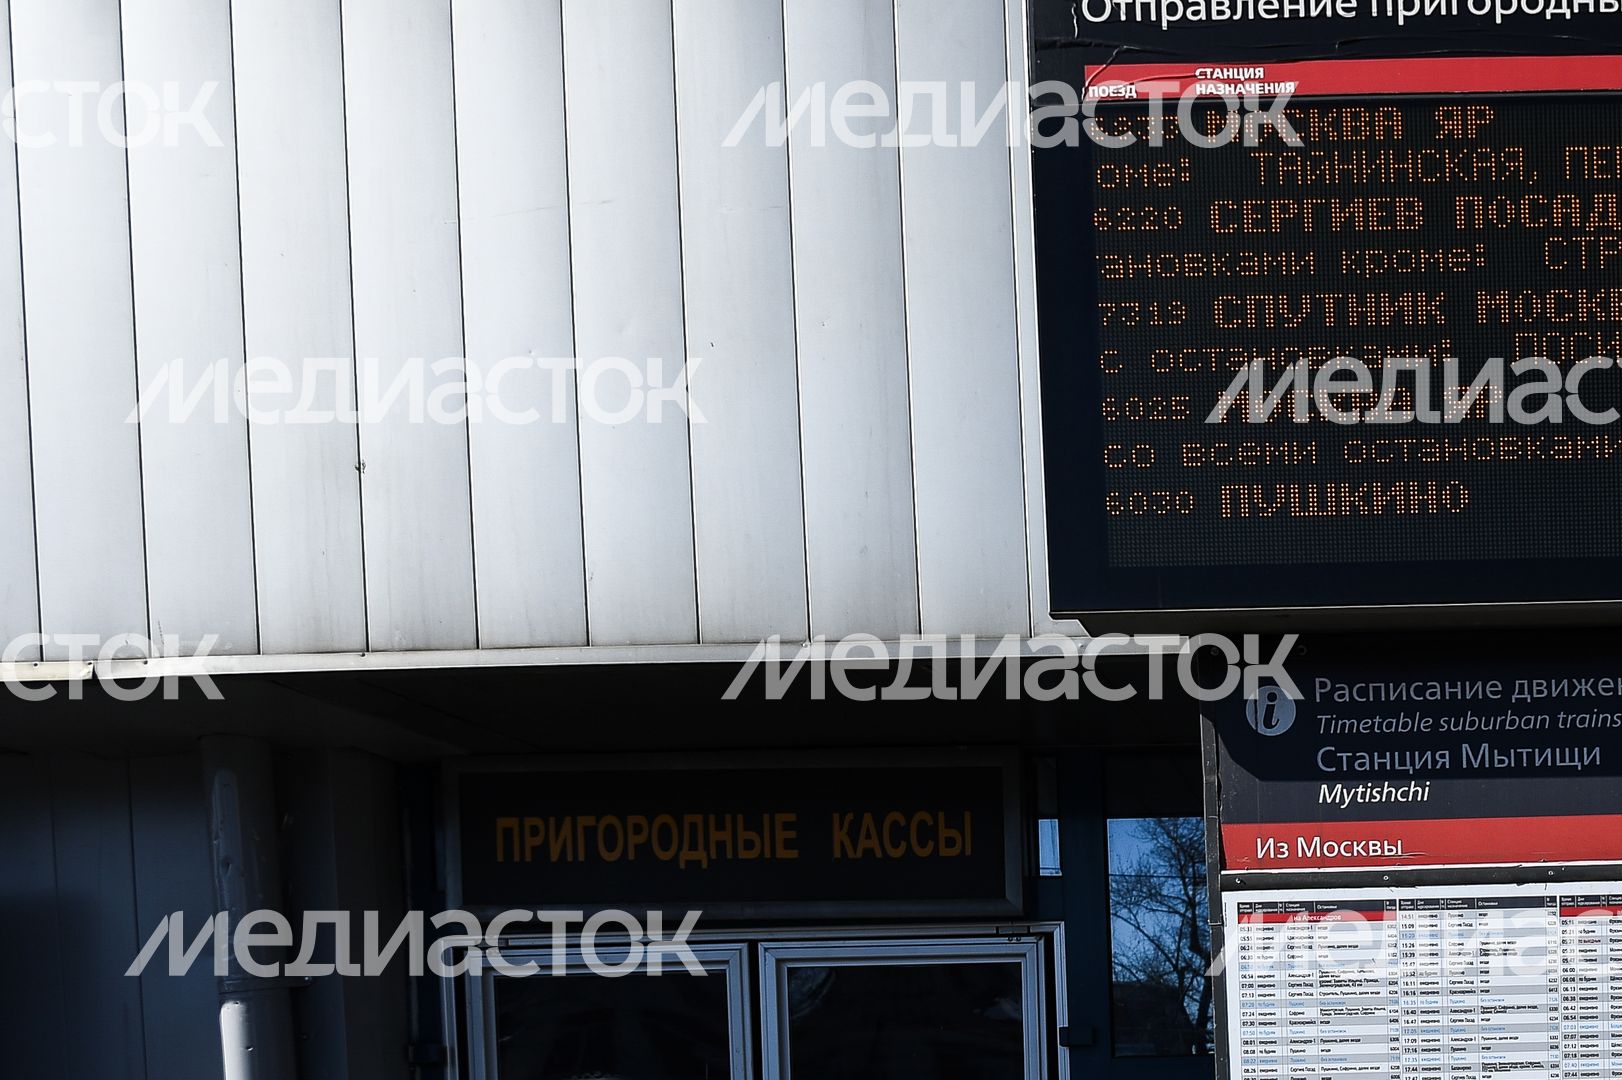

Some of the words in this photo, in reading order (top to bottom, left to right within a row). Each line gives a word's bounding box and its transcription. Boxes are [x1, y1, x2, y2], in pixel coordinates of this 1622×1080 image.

[1083, 0, 1357, 30] Отправление
[1195, 67, 1264, 81] СТАНЦИЯ
[1089, 85, 1137, 98] ПОЕЗД
[1195, 82, 1296, 95] НАЗНАЧЕНИЯ
[1435, 106, 1494, 139] ЯР
[1094, 206, 1182, 230] 6220
[1210, 197, 1423, 233] СЕРГИЕВ
[1456, 194, 1621, 231] ПОСАД
[1214, 292, 1445, 328] СПУТНИК
[1104, 444, 1154, 468] со
[1182, 441, 1316, 466] всеми
[1106, 491, 1193, 515] 6030
[1221, 481, 1469, 518] ПУШКИНО
[1315, 676, 1502, 702] Расписание
[1316, 712, 1433, 735] Timetable
[1439, 710, 1550, 733] suburban
[1556, 708, 1622, 730] trains
[1316, 746, 1451, 775] Станция
[1461, 742, 1601, 771] Мытищи
[1318, 780, 1431, 811] Mytishchi
[496, 812, 799, 870] ПРИГОРОДНЫЕ
[831, 810, 973, 859] КАССЫ
[1256, 837, 1289, 859] Из
[1297, 836, 1402, 858] Москвы
